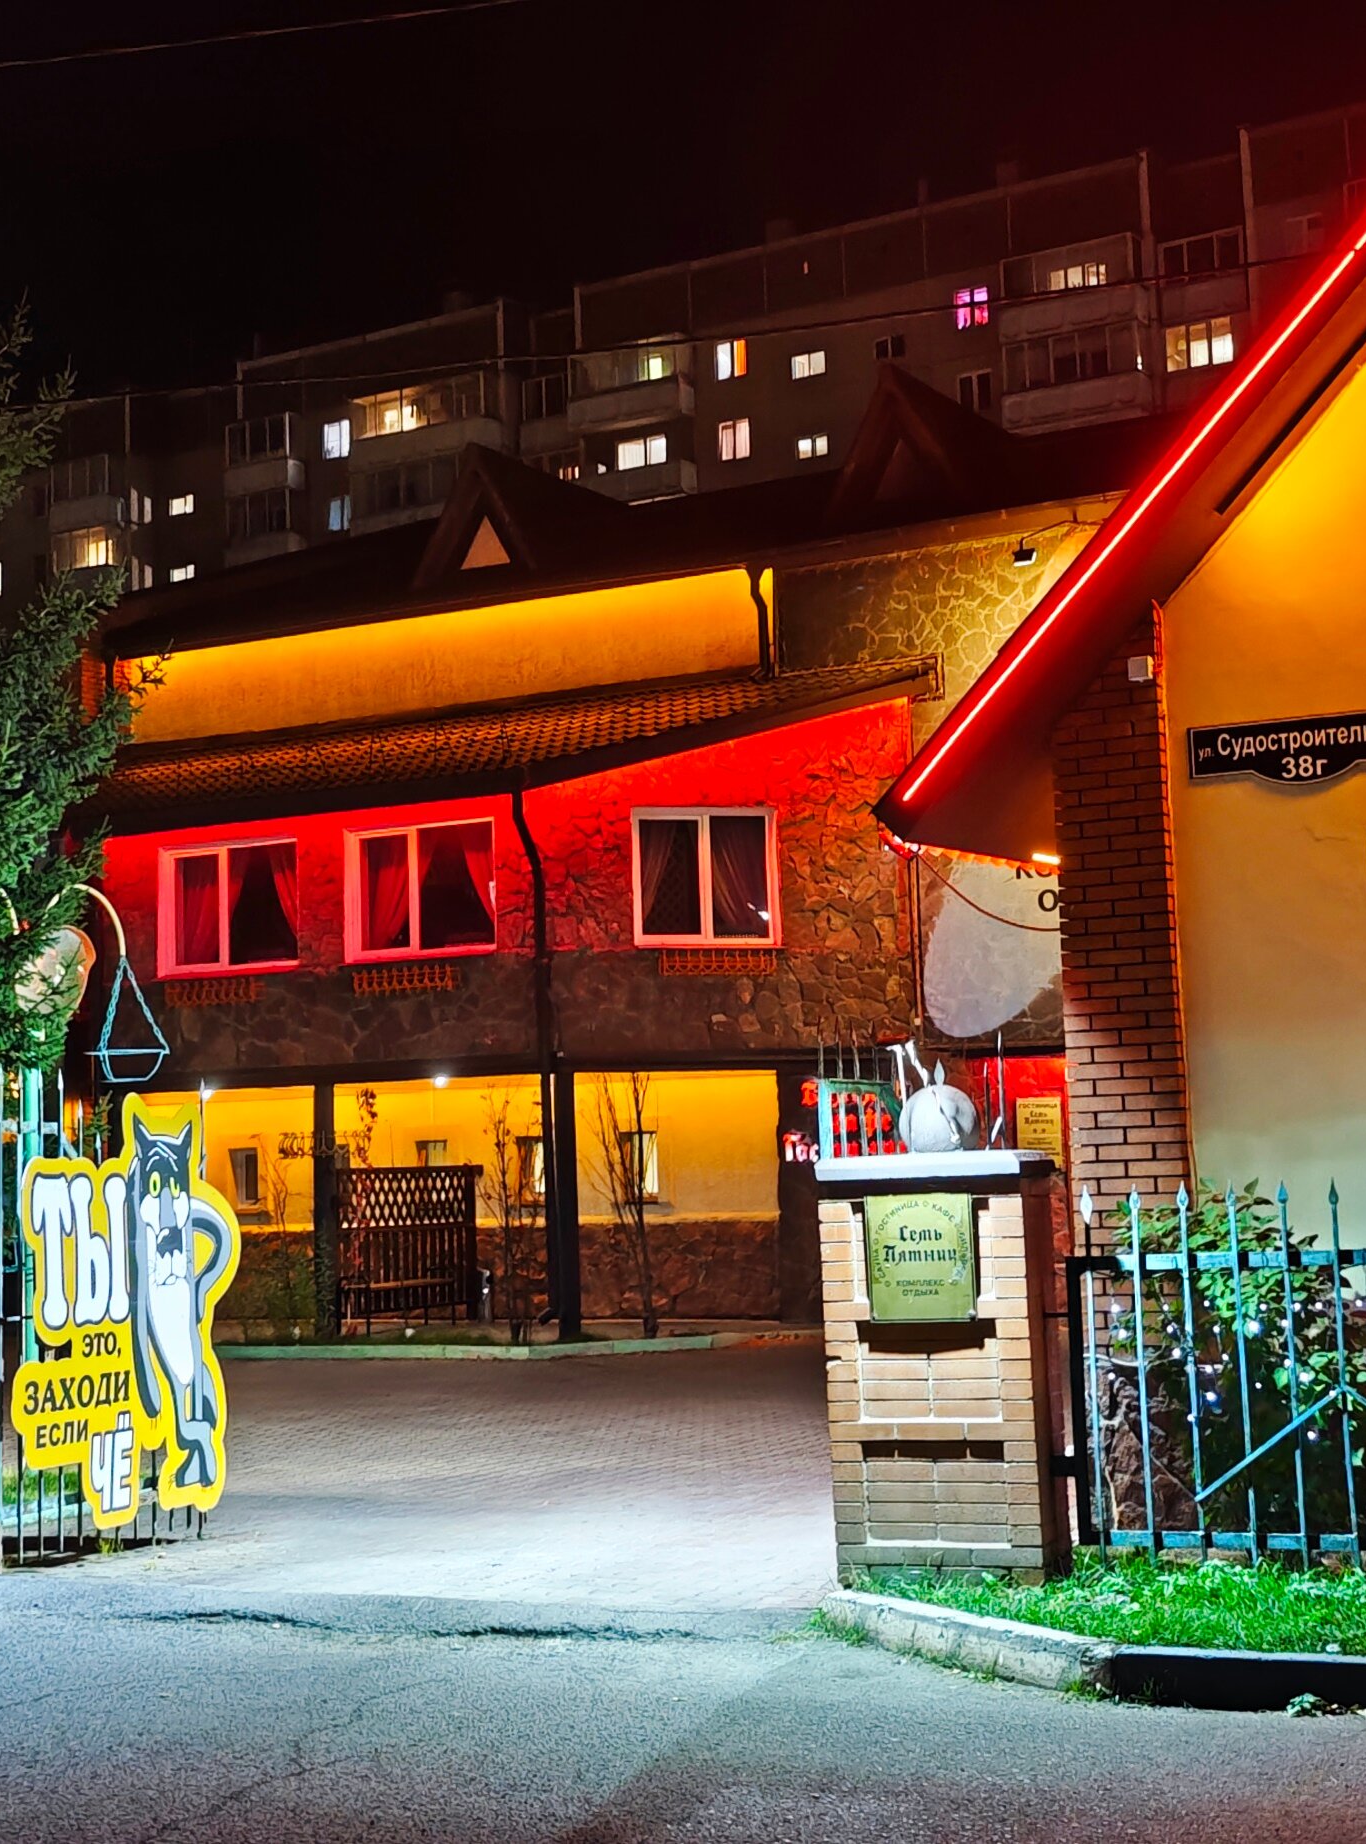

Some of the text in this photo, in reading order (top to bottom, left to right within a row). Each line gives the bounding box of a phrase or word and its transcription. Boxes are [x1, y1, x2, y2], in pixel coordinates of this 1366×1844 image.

[1198, 747, 1215, 762] ул.
[1281, 755, 1328, 779] 38г
[898, 1223, 943, 1245] Семь
[31, 1172, 131, 1331] ТЫ
[882, 1244, 958, 1267] Пятниц
[895, 1278, 946, 1287] КОМПЛЕКС
[901, 1288, 940, 1298] ОТДЫХА
[81, 1331, 122, 1358] ЭТО,
[23, 1369, 131, 1416] ЗАХОДИ
[35, 1418, 89, 1449] ЕСЛИ
[90, 1410, 134, 1514] ЧЁ
